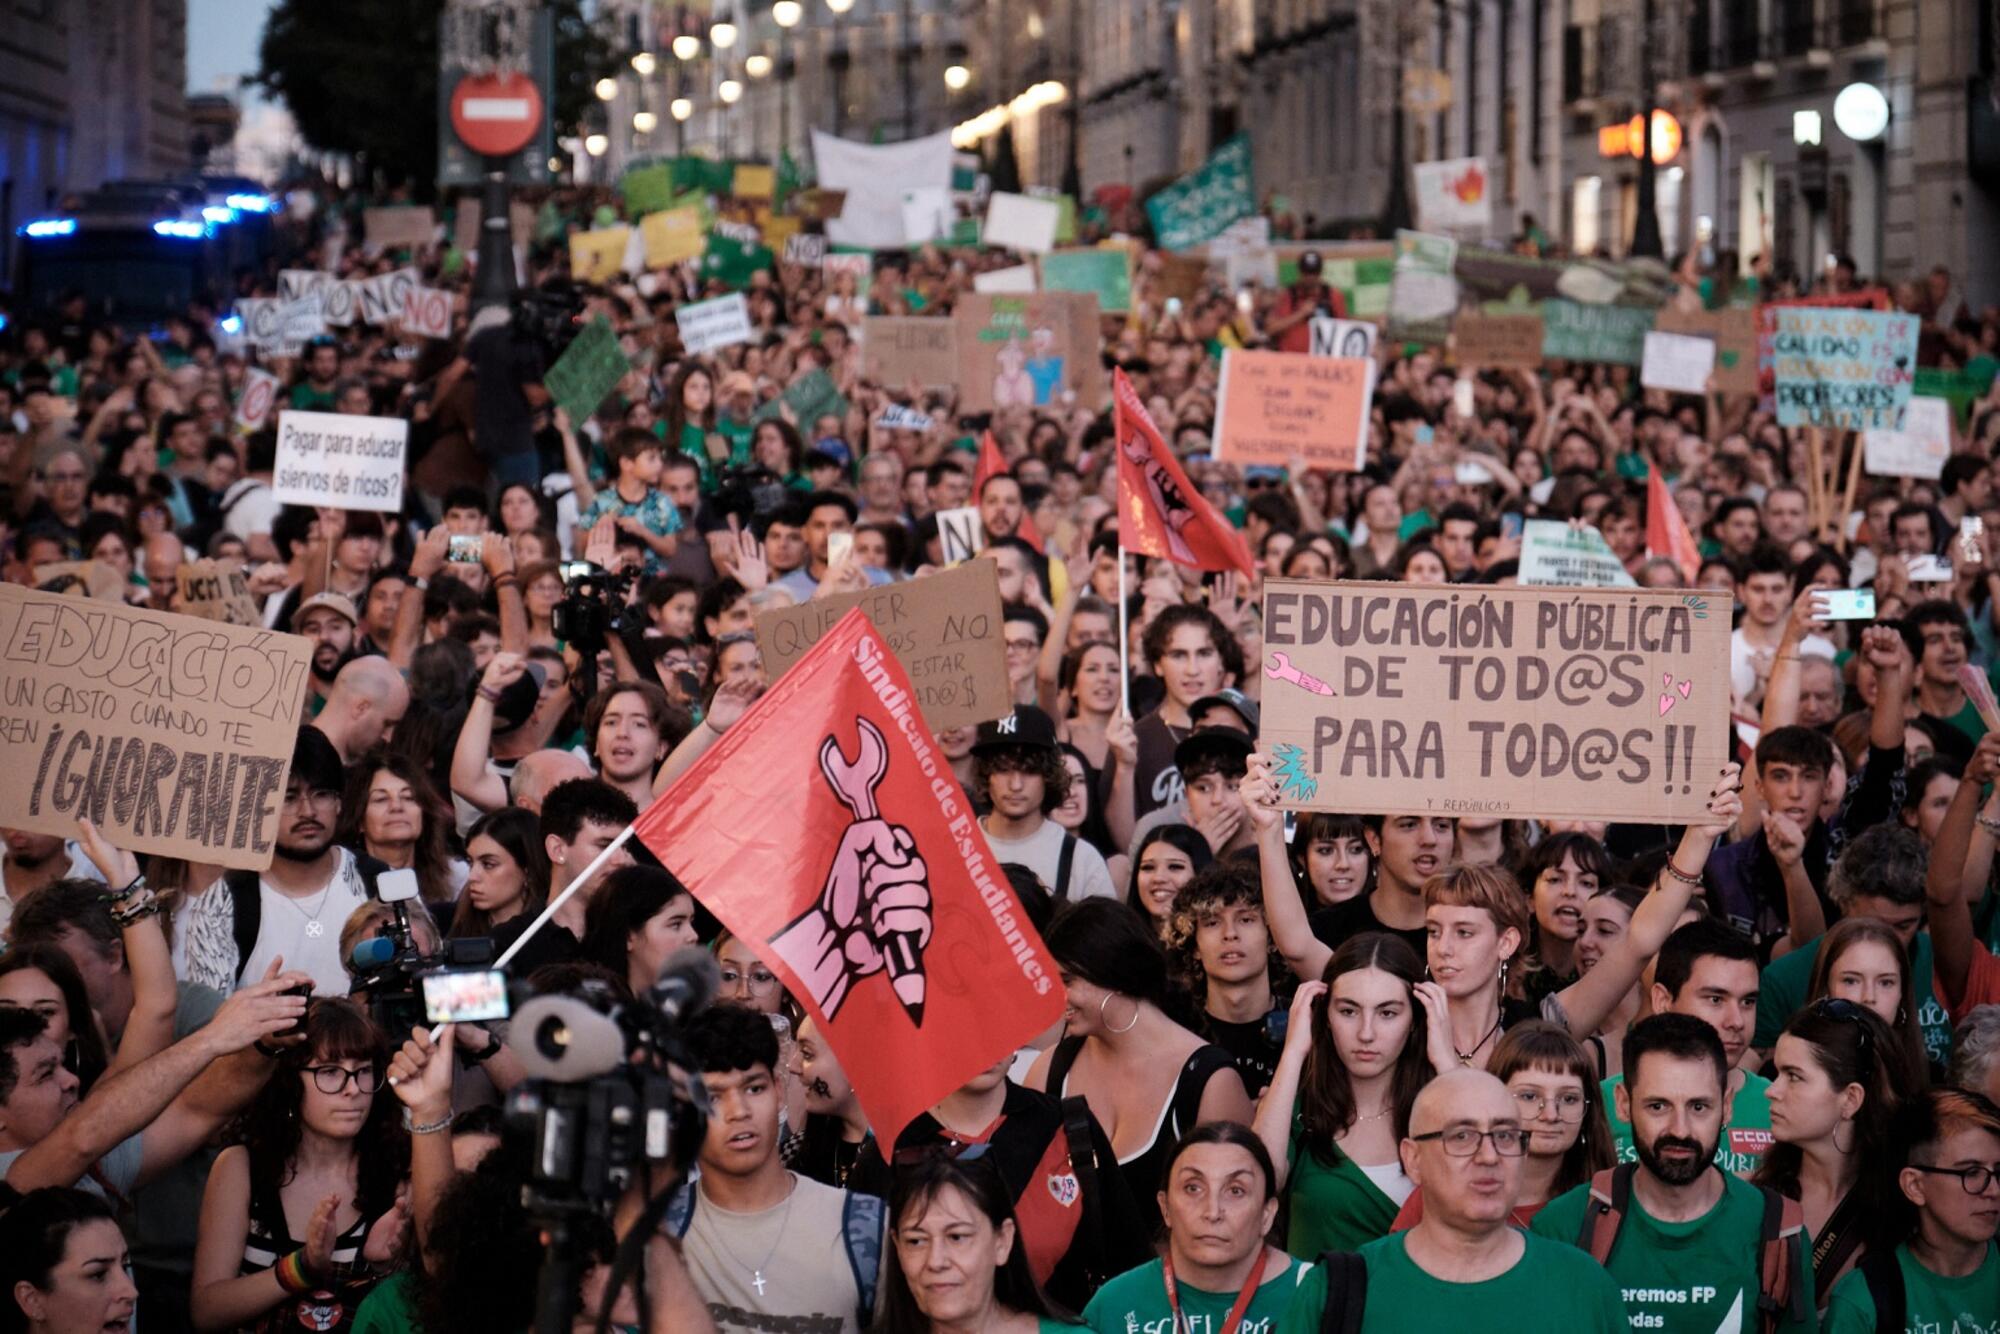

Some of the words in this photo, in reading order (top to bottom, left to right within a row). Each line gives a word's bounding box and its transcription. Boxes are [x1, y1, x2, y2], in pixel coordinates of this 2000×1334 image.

[404, 291, 447, 331] NO
[1315, 322, 1369, 357] NO
[1776, 334, 1861, 359] CALIDAD
[1777, 383, 1895, 408] PROFESORES
[284, 423, 322, 457] Pagar
[324, 432, 354, 459] para
[357, 432, 403, 459] educar
[278, 465, 330, 492] siervos
[333, 468, 349, 494] de
[353, 470, 400, 498] ricos?
[184, 576, 222, 602] UCM
[942, 613, 990, 643] NO
[912, 653, 966, 673] ESTAR
[1344, 656, 1407, 698] DE
[1439, 653, 1646, 708] TOD@S
[4, 675, 36, 707] UN
[43, 682, 117, 721] GASTO
[130, 700, 208, 737] CUANDO
[220, 720, 254, 748] TE
[1313, 716, 1445, 780] PARA
[851, 634, 938, 779] Sindicato
[931, 777, 958, 817] de
[950, 814, 1053, 997] Estudiantes
[1426, 798, 1434, 809] Y
[1812, 1231, 1838, 1270] Nikon
[1691, 1286, 1717, 1304] FP
